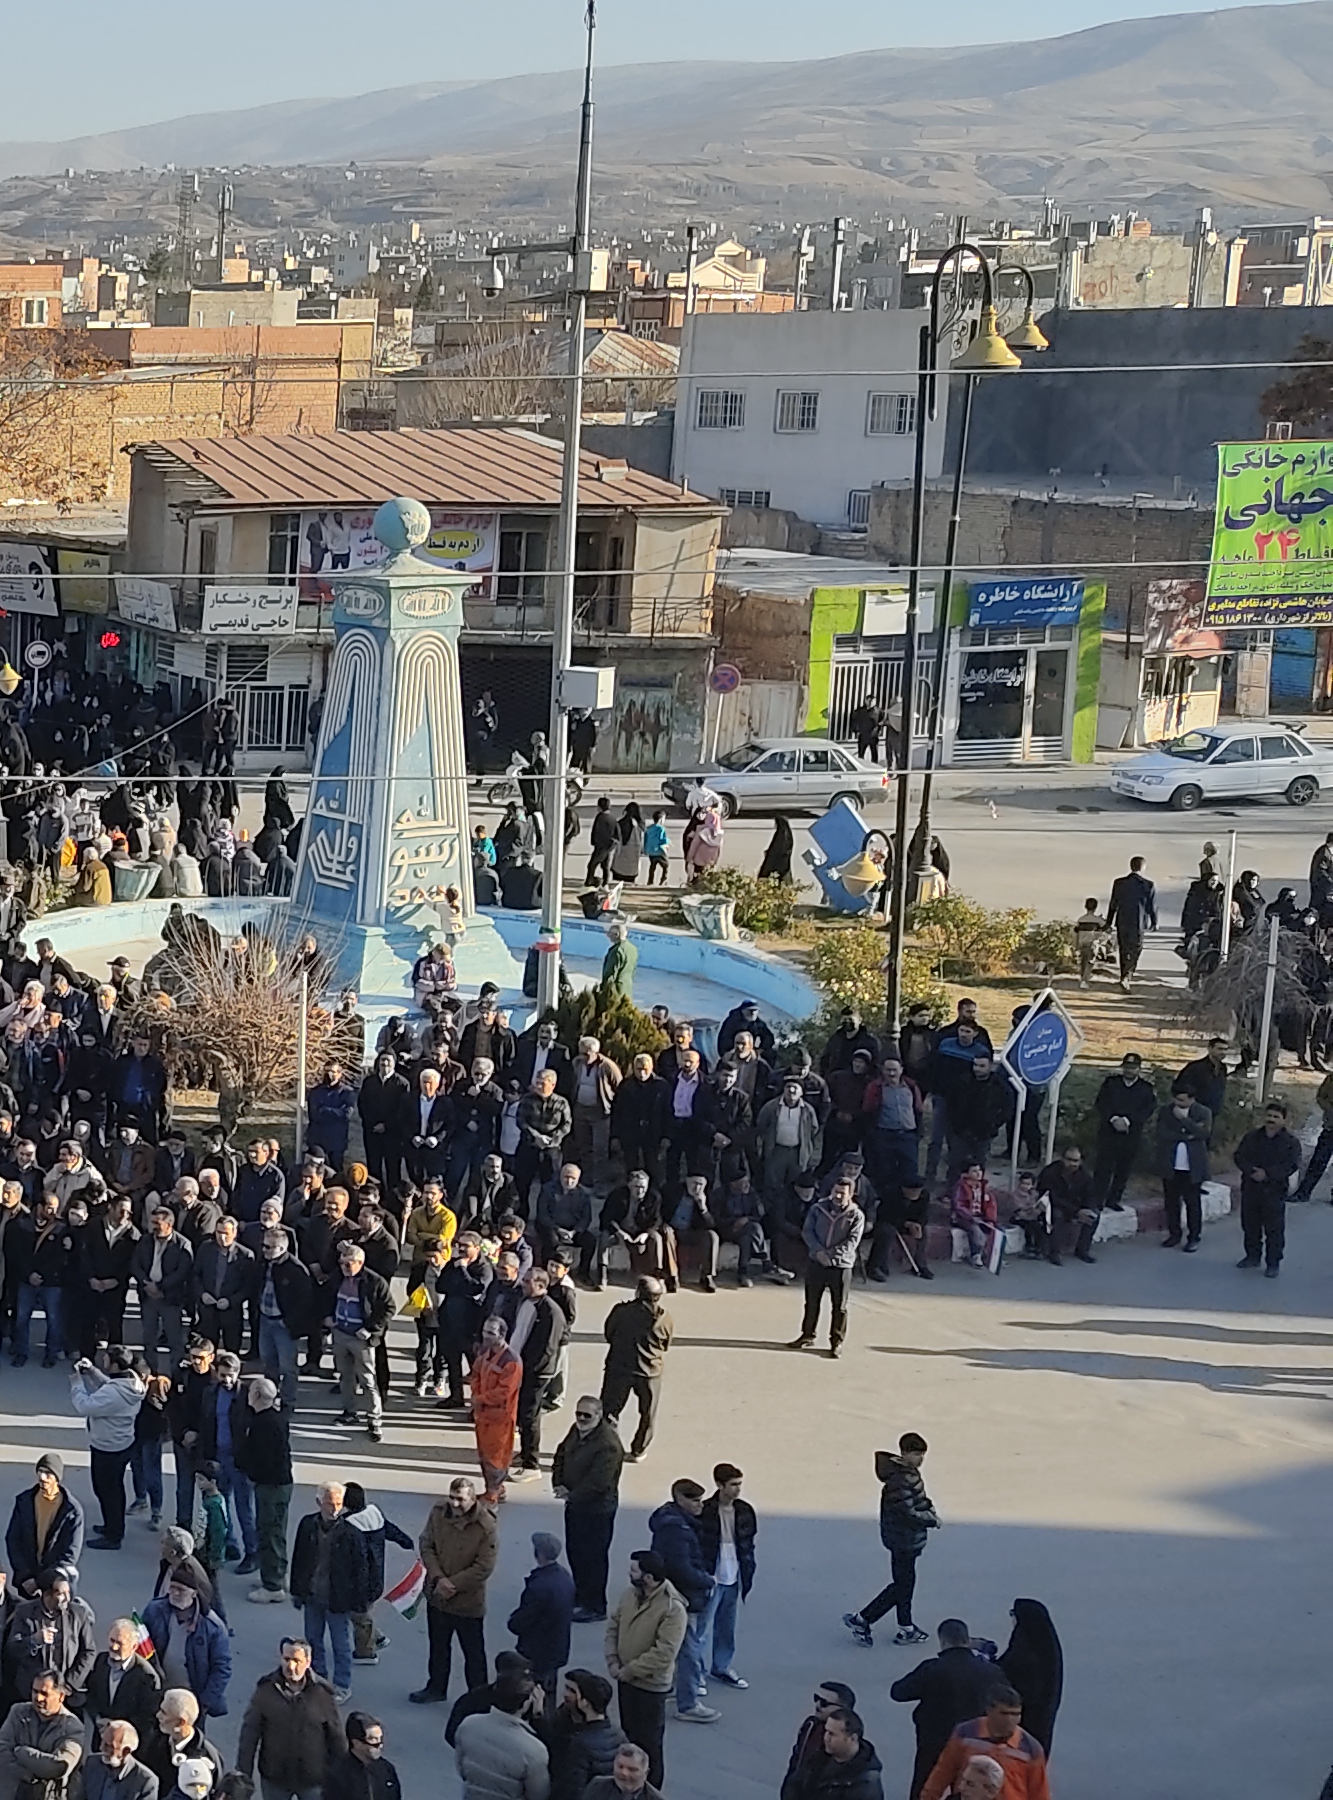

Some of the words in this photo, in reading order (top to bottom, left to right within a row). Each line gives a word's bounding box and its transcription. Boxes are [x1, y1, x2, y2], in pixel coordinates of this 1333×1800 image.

[1222, 446, 1288, 478] خانگی
[1291, 445, 1333, 475] وازم
[1223, 474, 1333, 530] جهانی
[458, 539, 470, 552] دم
[471, 537, 480, 552] از
[1254, 528, 1301, 566] ۲۴
[209, 592, 251, 608] خشکبار
[258, 589, 294, 610] برنج
[978, 586, 1021, 607] خاطره
[1023, 581, 1081, 602] آرایشگاه
[1307, 595, 1333, 609] خیابان
[209, 613, 250, 632] قدیمی
[251, 614, 290, 632] حاجی
[992, 658, 1027, 688] آرایشگاه
